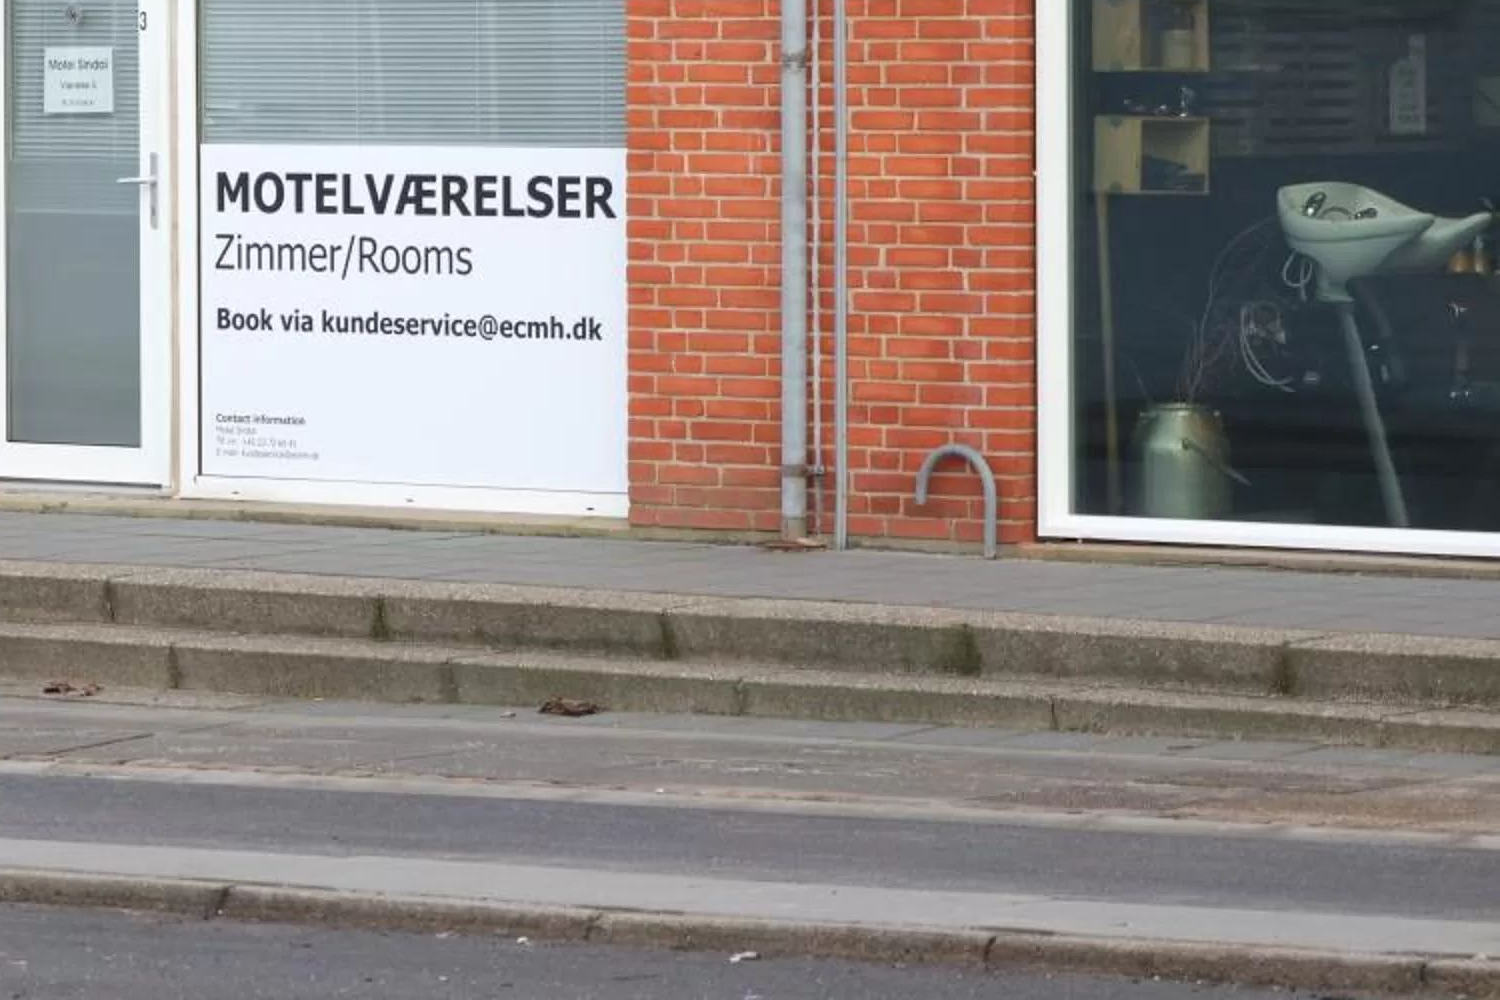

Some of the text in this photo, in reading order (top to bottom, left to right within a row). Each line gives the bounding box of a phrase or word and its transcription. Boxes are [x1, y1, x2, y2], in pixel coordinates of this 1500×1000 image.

[139, 11, 148, 31] 3
[216, 171, 617, 219] MOTELVÆRELSER
[215, 233, 473, 280] Zimmer/Rooms
[217, 308, 603, 341] Book via kundeservice@ecmh.dk
[216, 413, 250, 424] Contact
